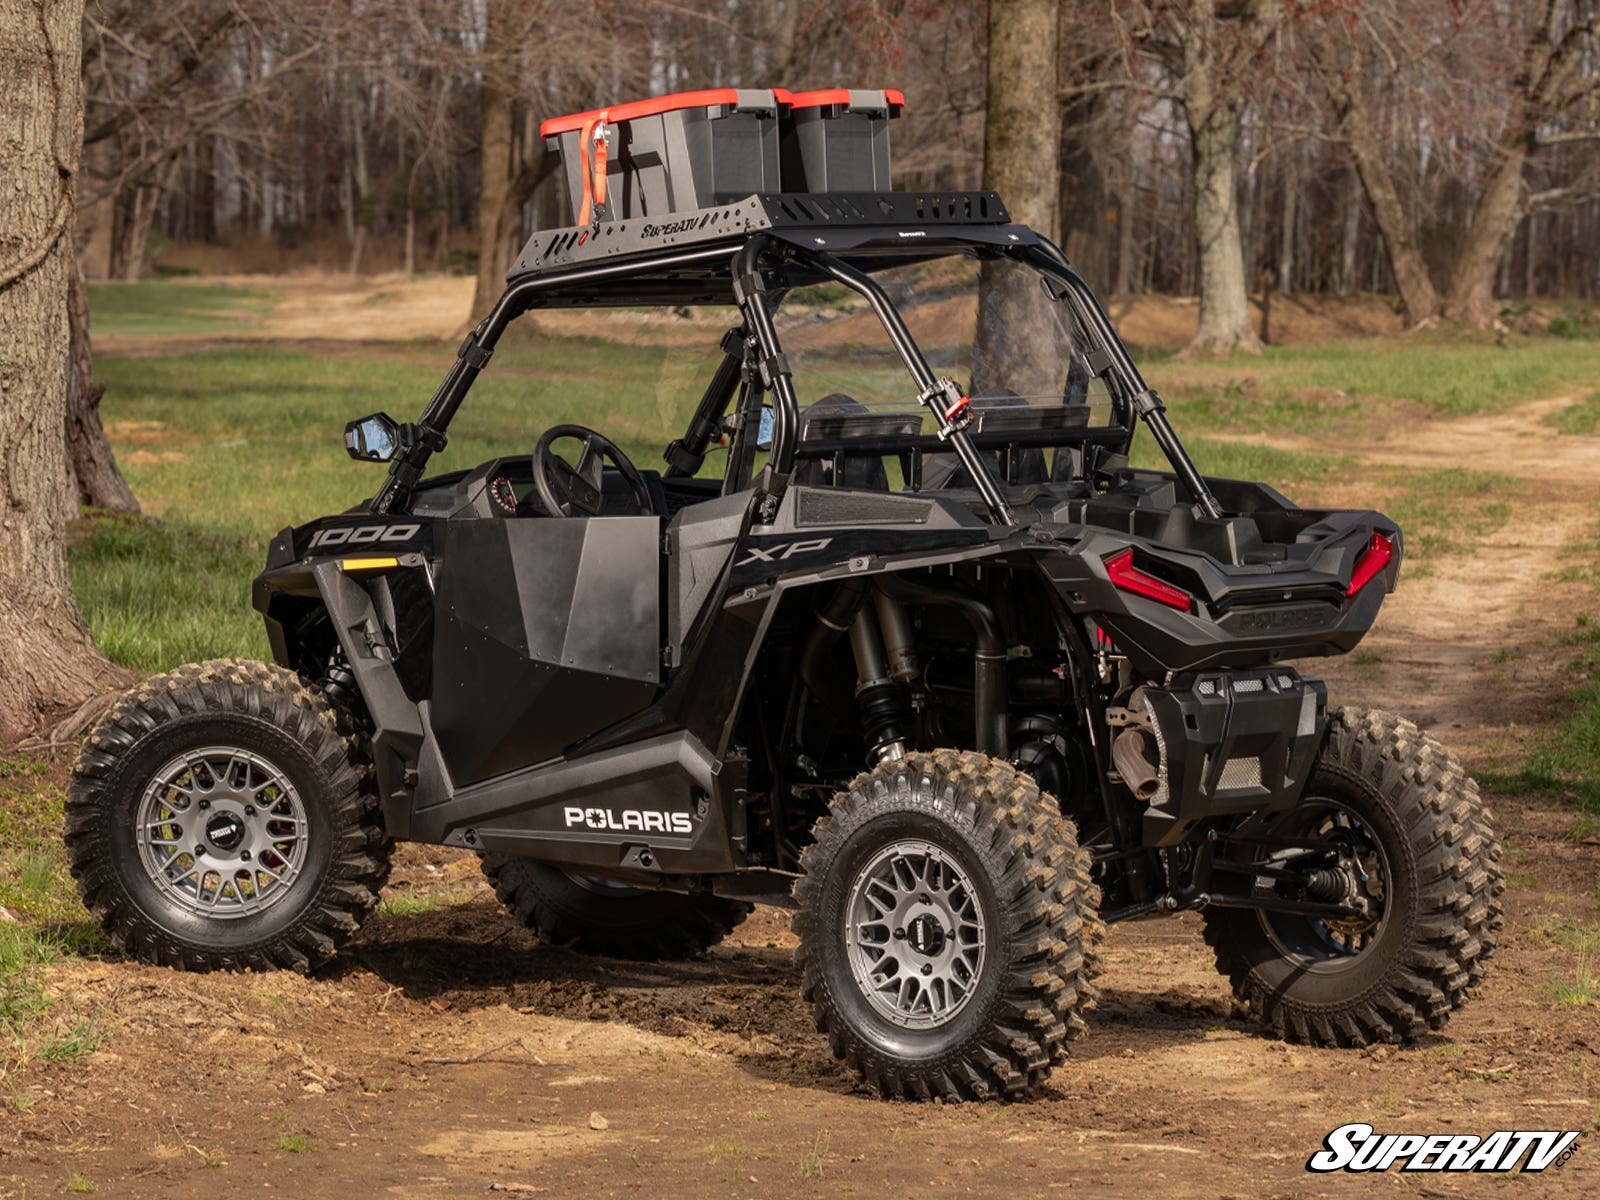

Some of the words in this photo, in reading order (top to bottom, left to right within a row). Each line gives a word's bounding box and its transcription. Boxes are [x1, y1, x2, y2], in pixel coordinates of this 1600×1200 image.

[308, 524, 420, 549] 1000
[735, 538, 833, 567] XP
[564, 806, 693, 833] POLARIS
